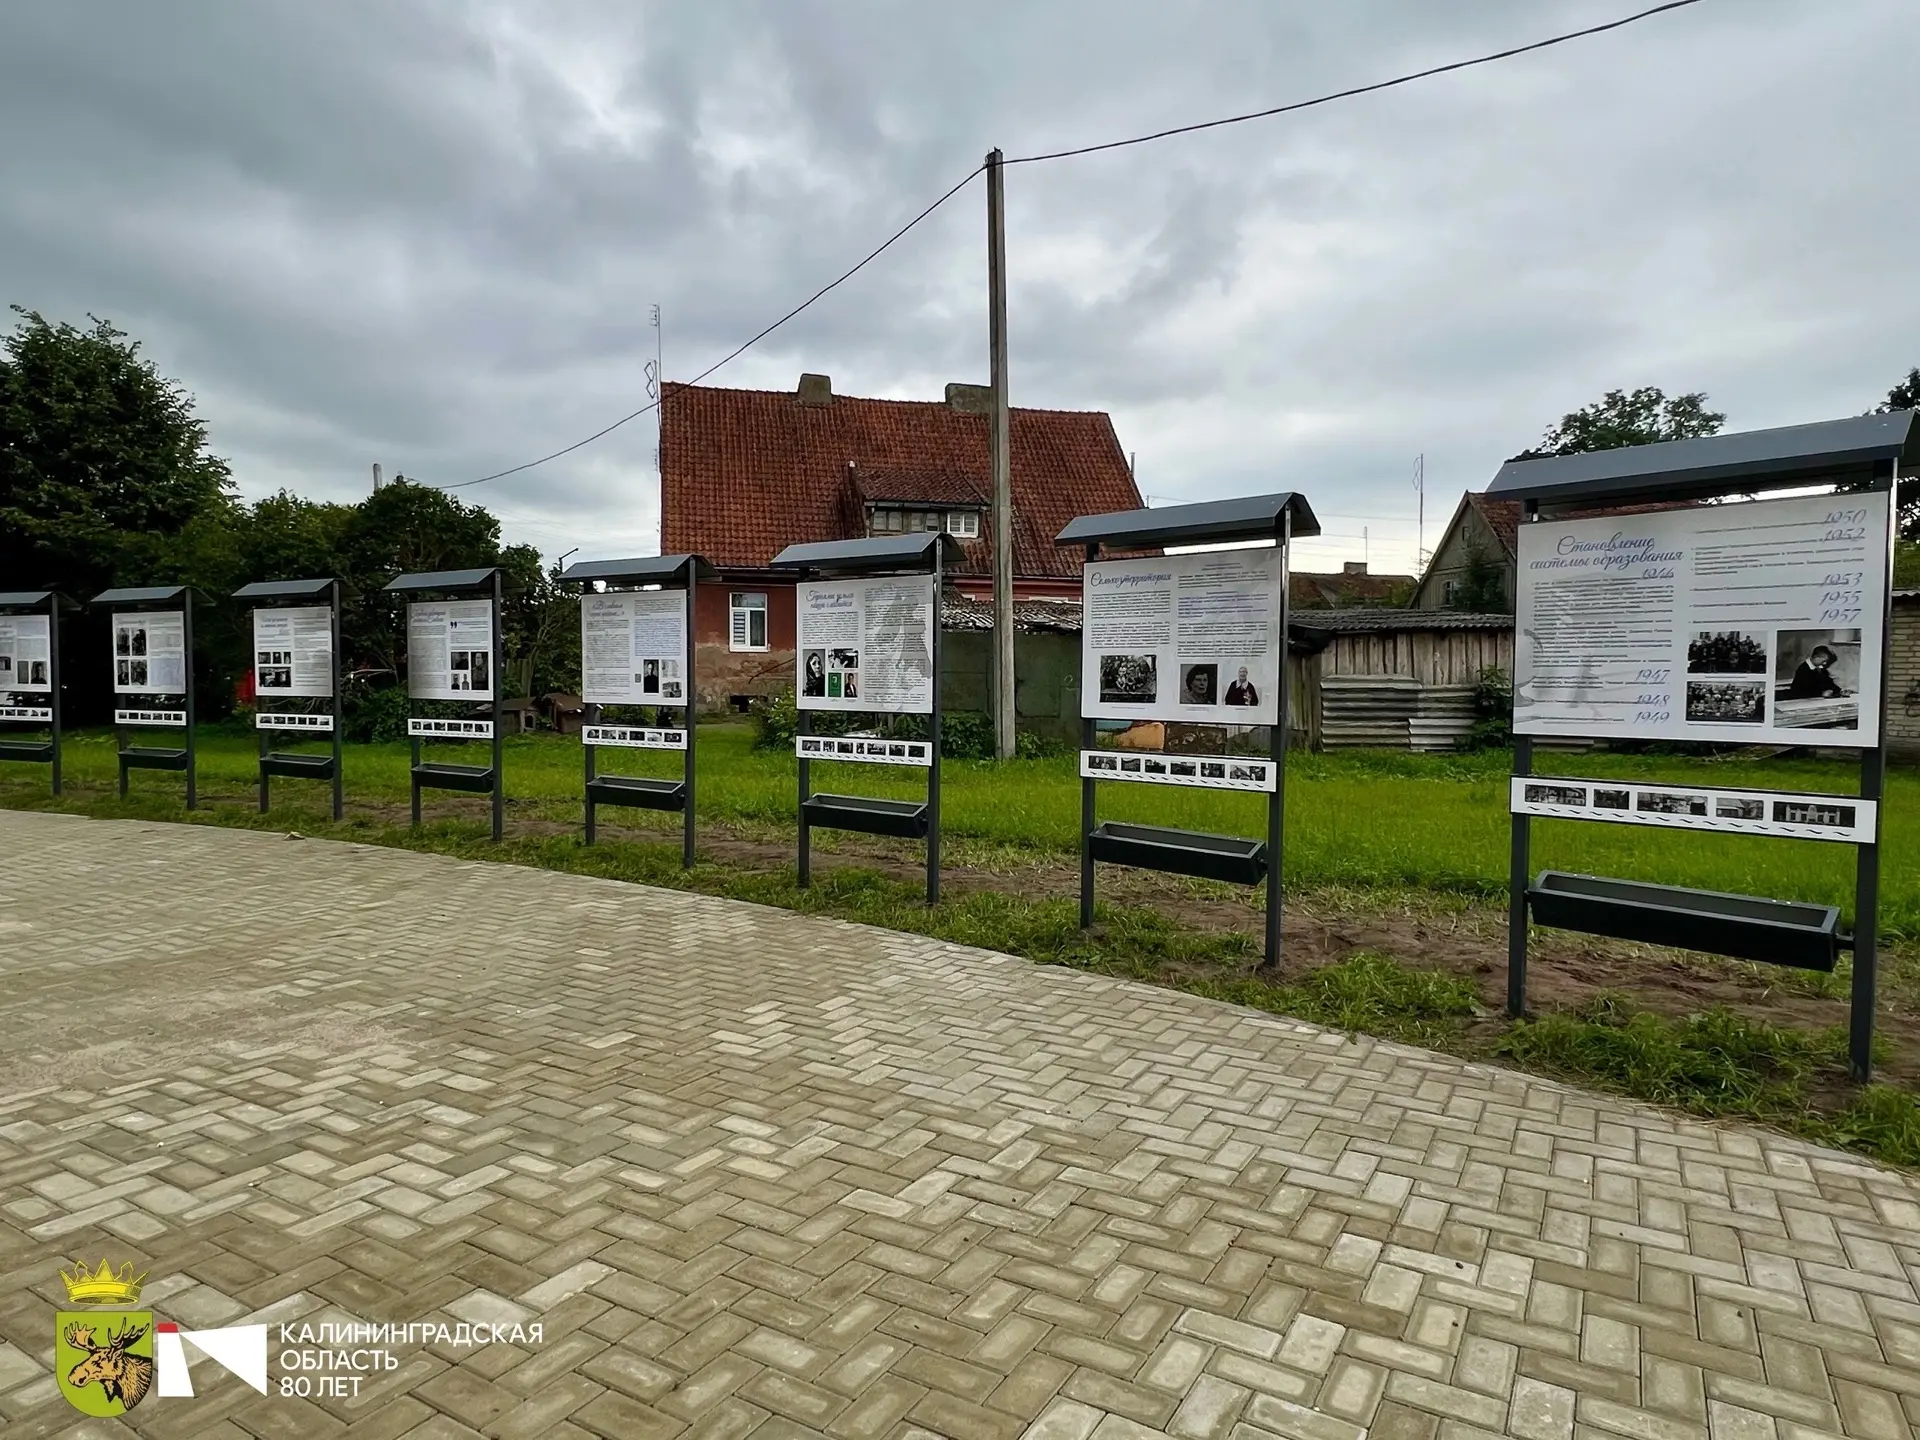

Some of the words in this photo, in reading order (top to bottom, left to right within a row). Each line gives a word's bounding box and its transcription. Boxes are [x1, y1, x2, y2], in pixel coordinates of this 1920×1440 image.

[1823, 508, 1867, 524] 1950
[1556, 531, 1656, 556] Становление
[1530, 556, 1590, 570] системы
[1592, 546, 1684, 571] образования
[1819, 590, 1862, 606] 1955
[1819, 608, 1862, 623] 1957
[1635, 669, 1671, 682] 1947
[1633, 711, 1670, 724] 1949
